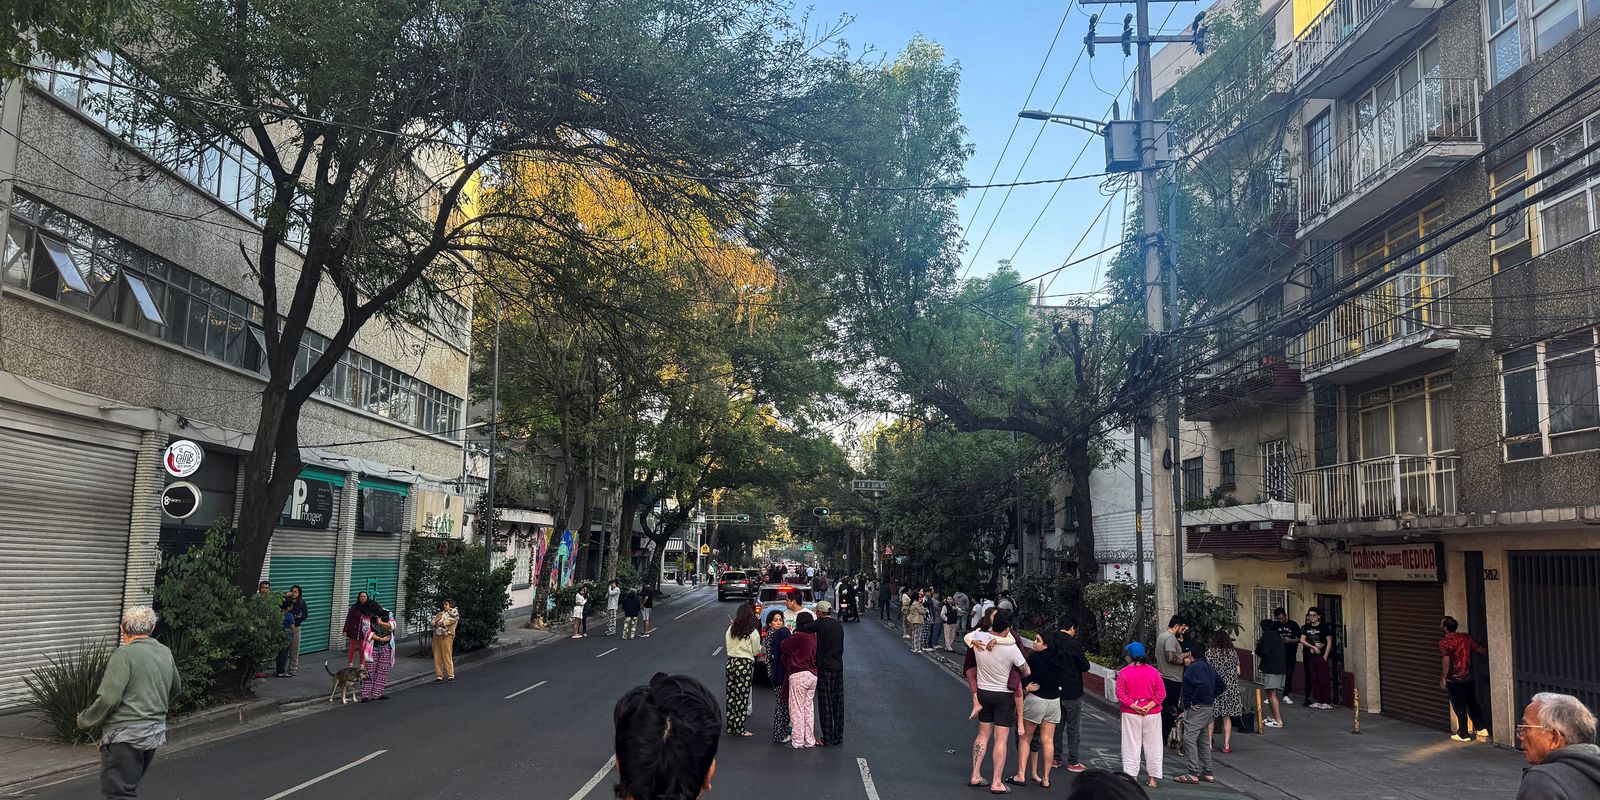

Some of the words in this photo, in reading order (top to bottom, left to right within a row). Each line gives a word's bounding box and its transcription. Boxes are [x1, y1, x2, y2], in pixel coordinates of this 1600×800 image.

[1352, 548, 1386, 570] CAMISAS
[1386, 553, 1402, 566] SOBRE
[1402, 548, 1435, 570] MEDIDA
